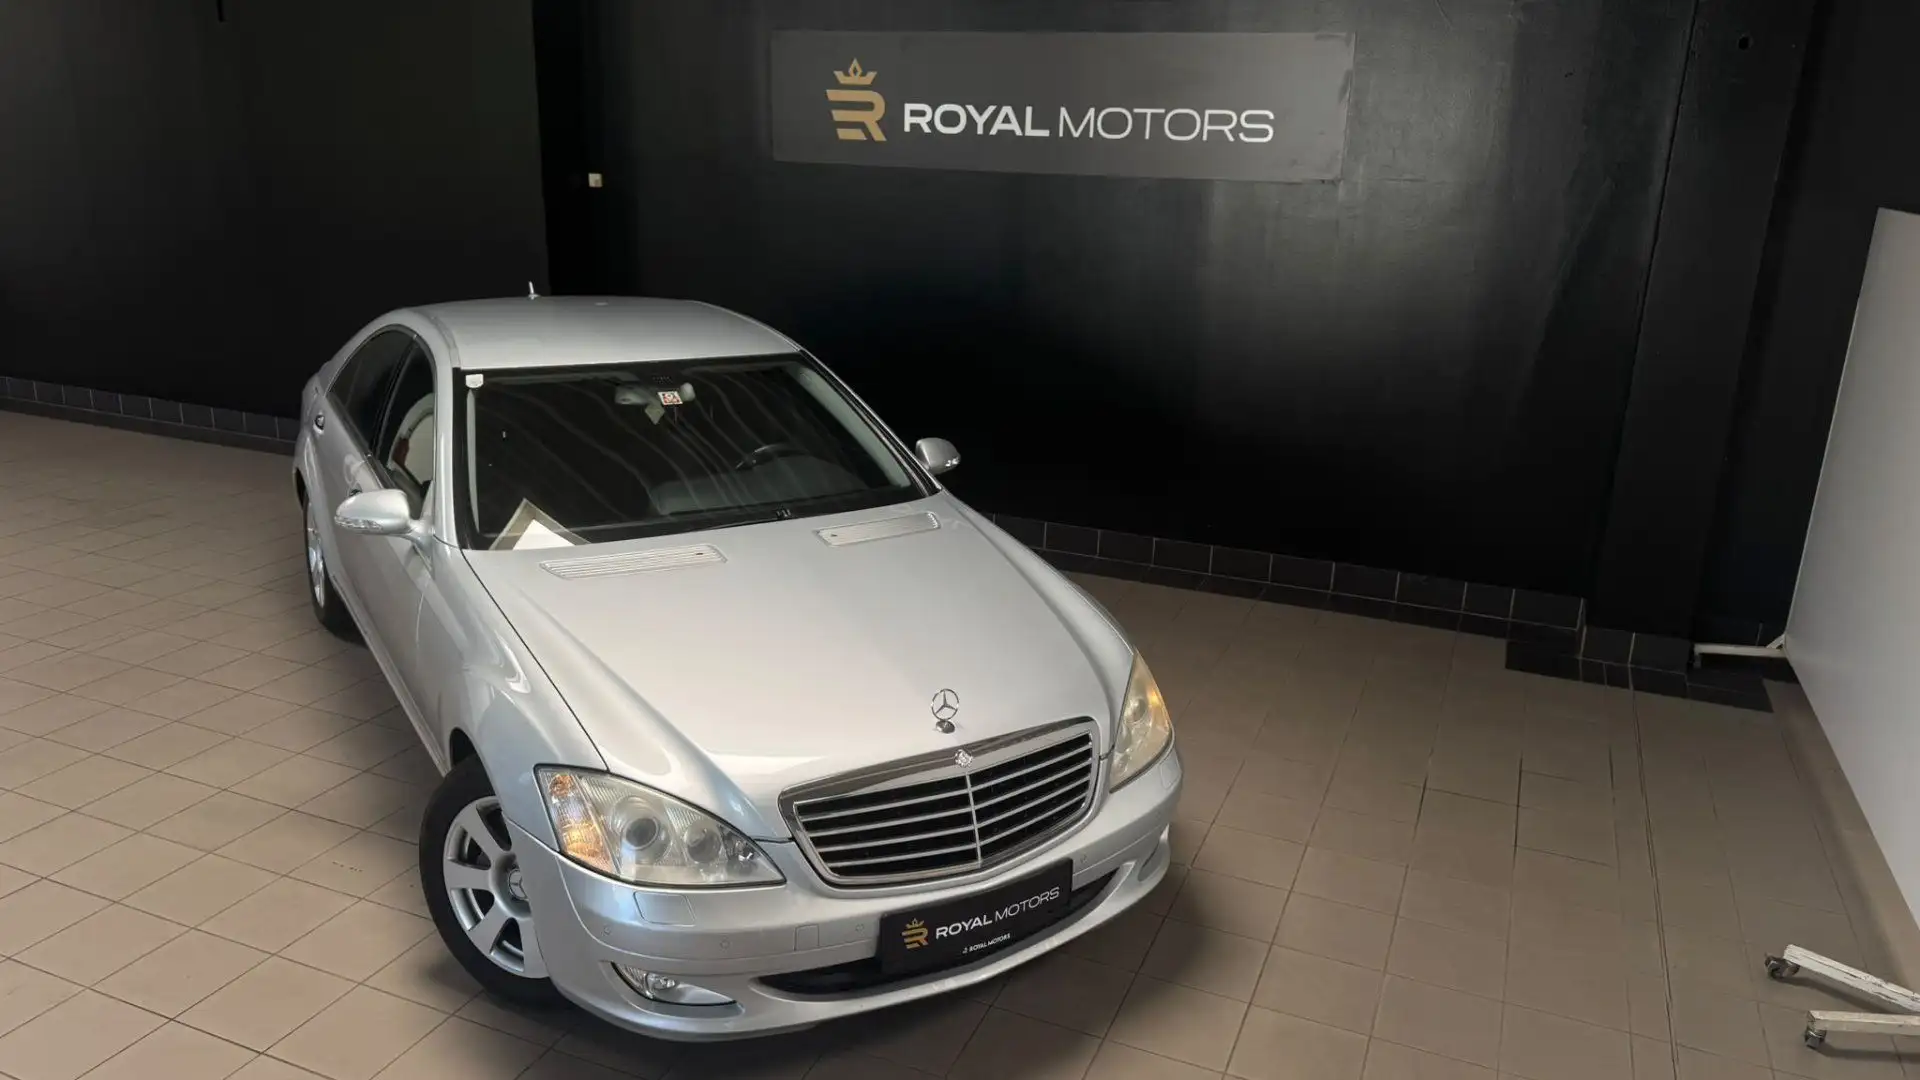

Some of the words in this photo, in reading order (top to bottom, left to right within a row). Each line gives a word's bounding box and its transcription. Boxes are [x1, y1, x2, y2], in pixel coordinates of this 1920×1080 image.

[903, 102, 1050, 137] ROYAL
[1058, 106, 1275, 144] MOTORS
[935, 914, 993, 940] ROYAL
[994, 886, 1060, 923] MOTORS
